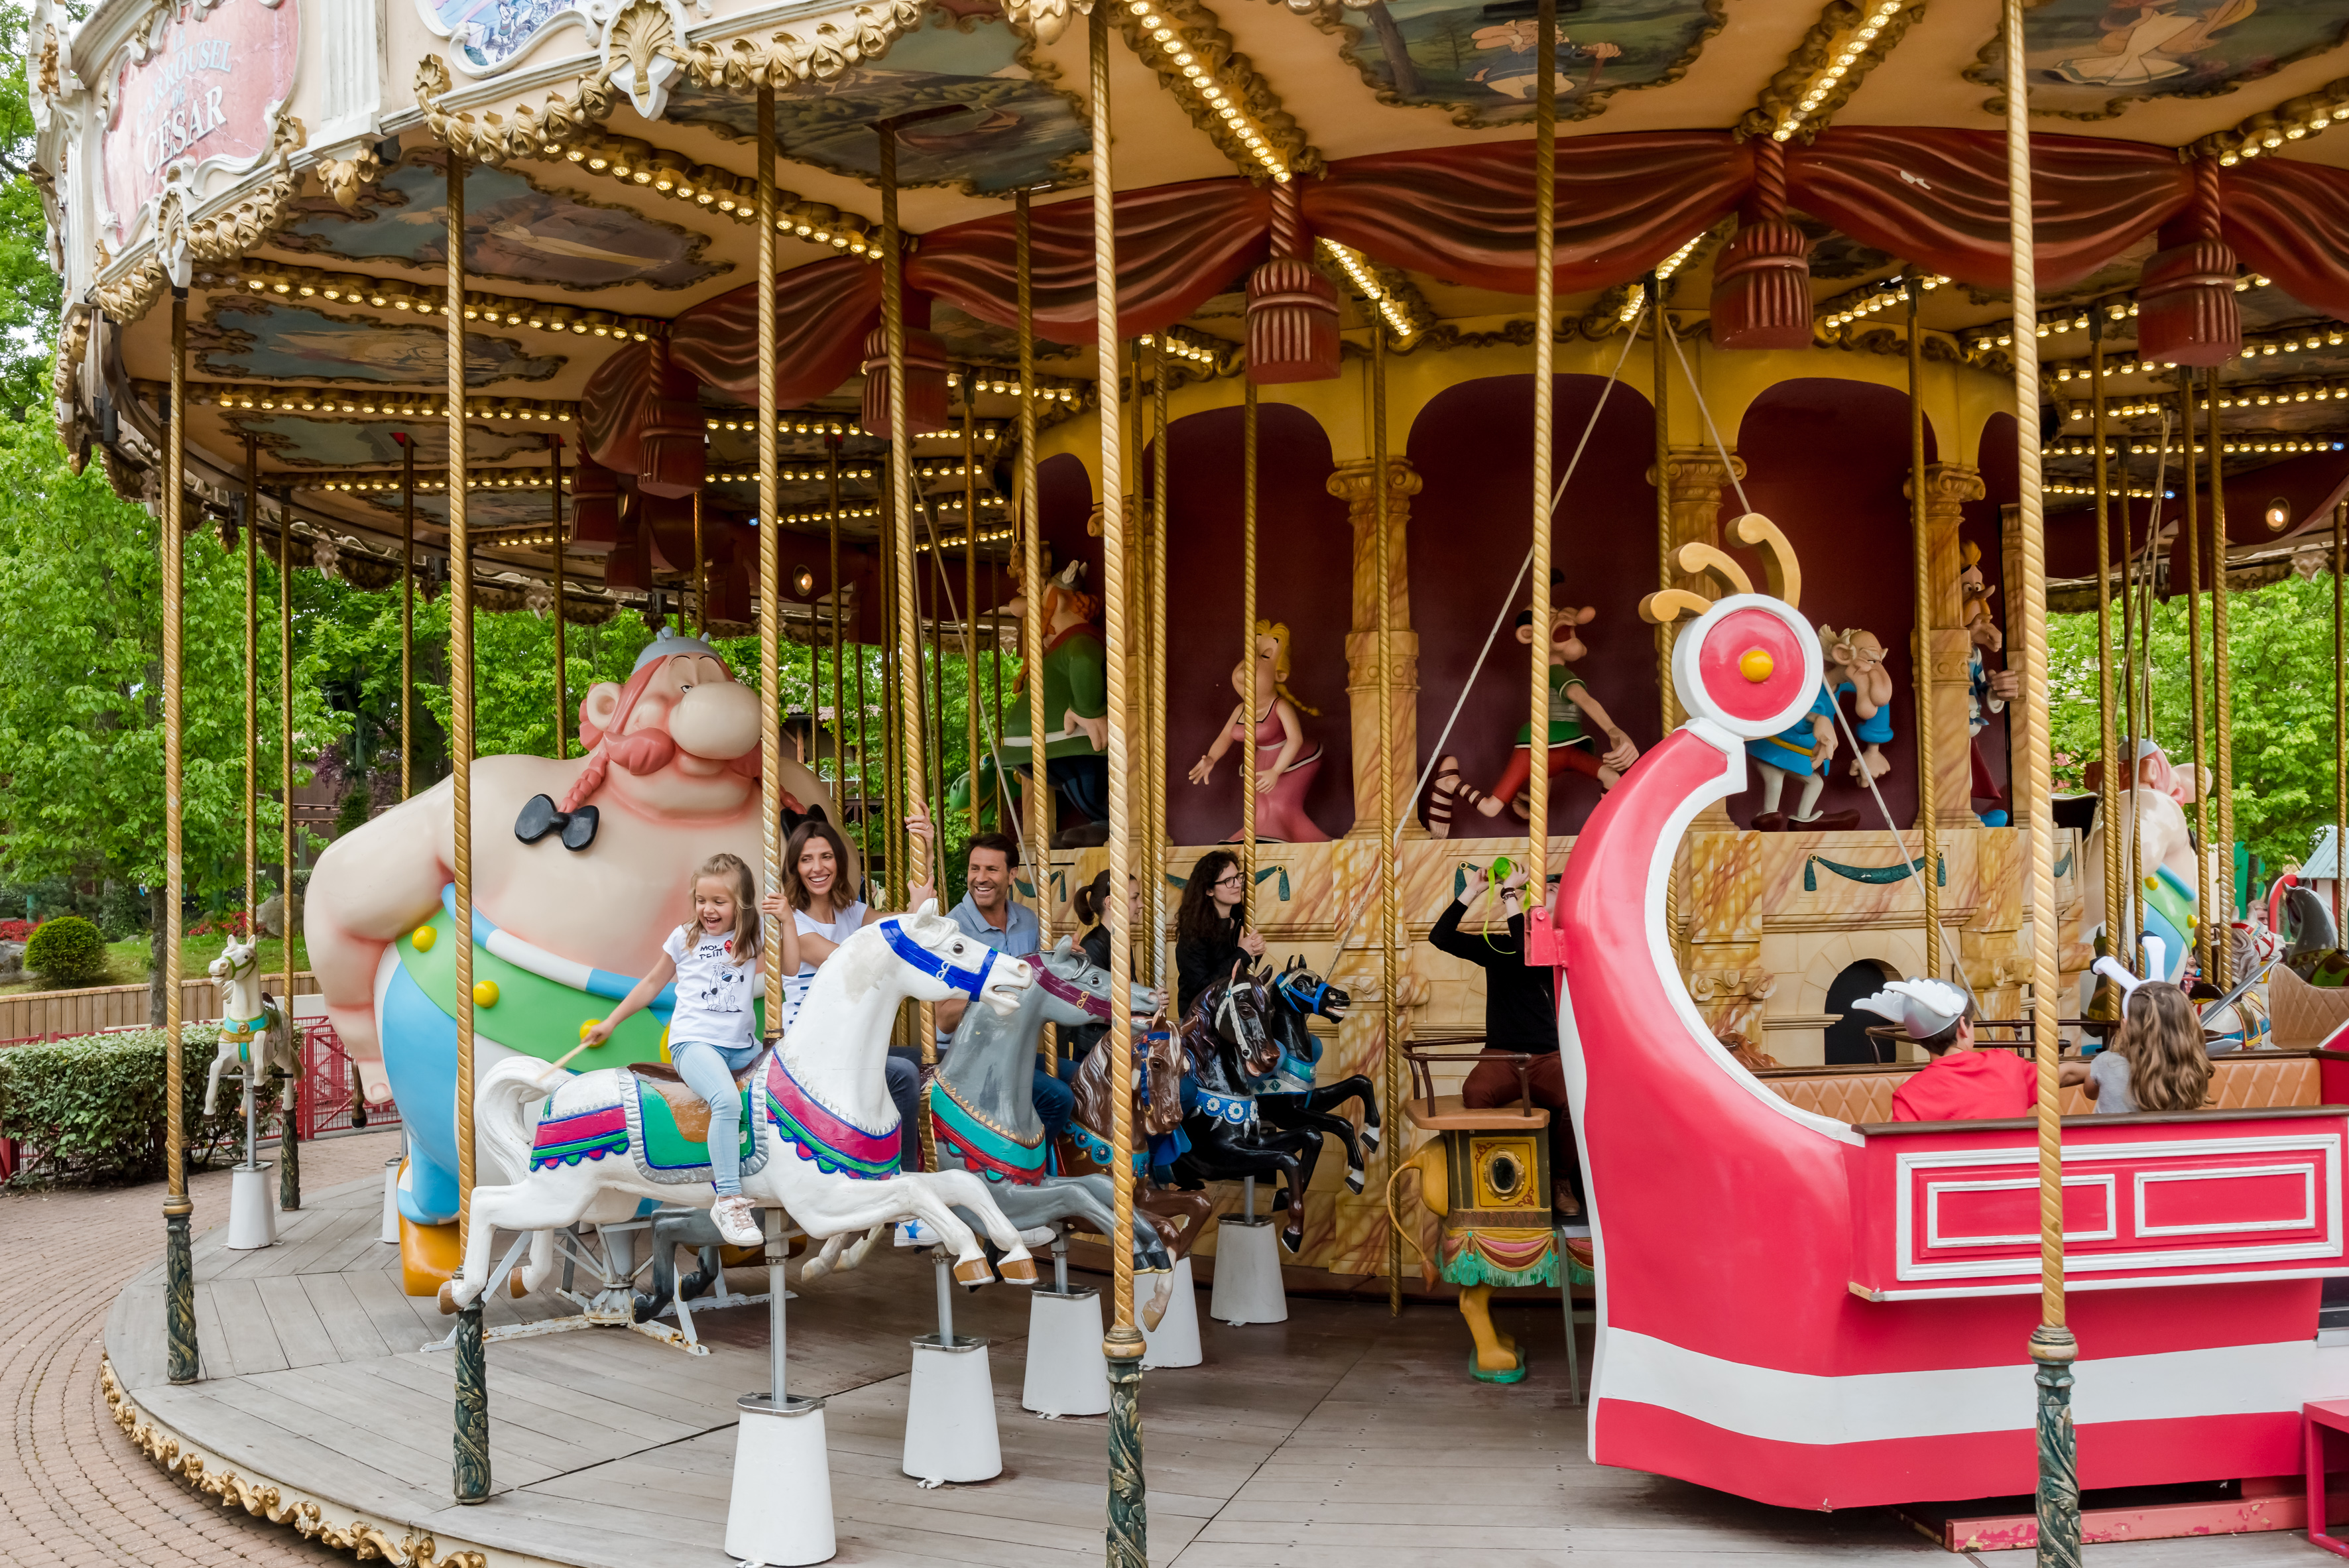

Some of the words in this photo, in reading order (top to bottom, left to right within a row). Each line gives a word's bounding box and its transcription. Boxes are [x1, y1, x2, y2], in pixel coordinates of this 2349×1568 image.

[173, 28, 186, 52] LE
[136, 39, 232, 138] CARROUSEL
[172, 83, 186, 111] DE
[143, 85, 227, 175] CÉSAR
[699, 948, 723, 960] PETIT
